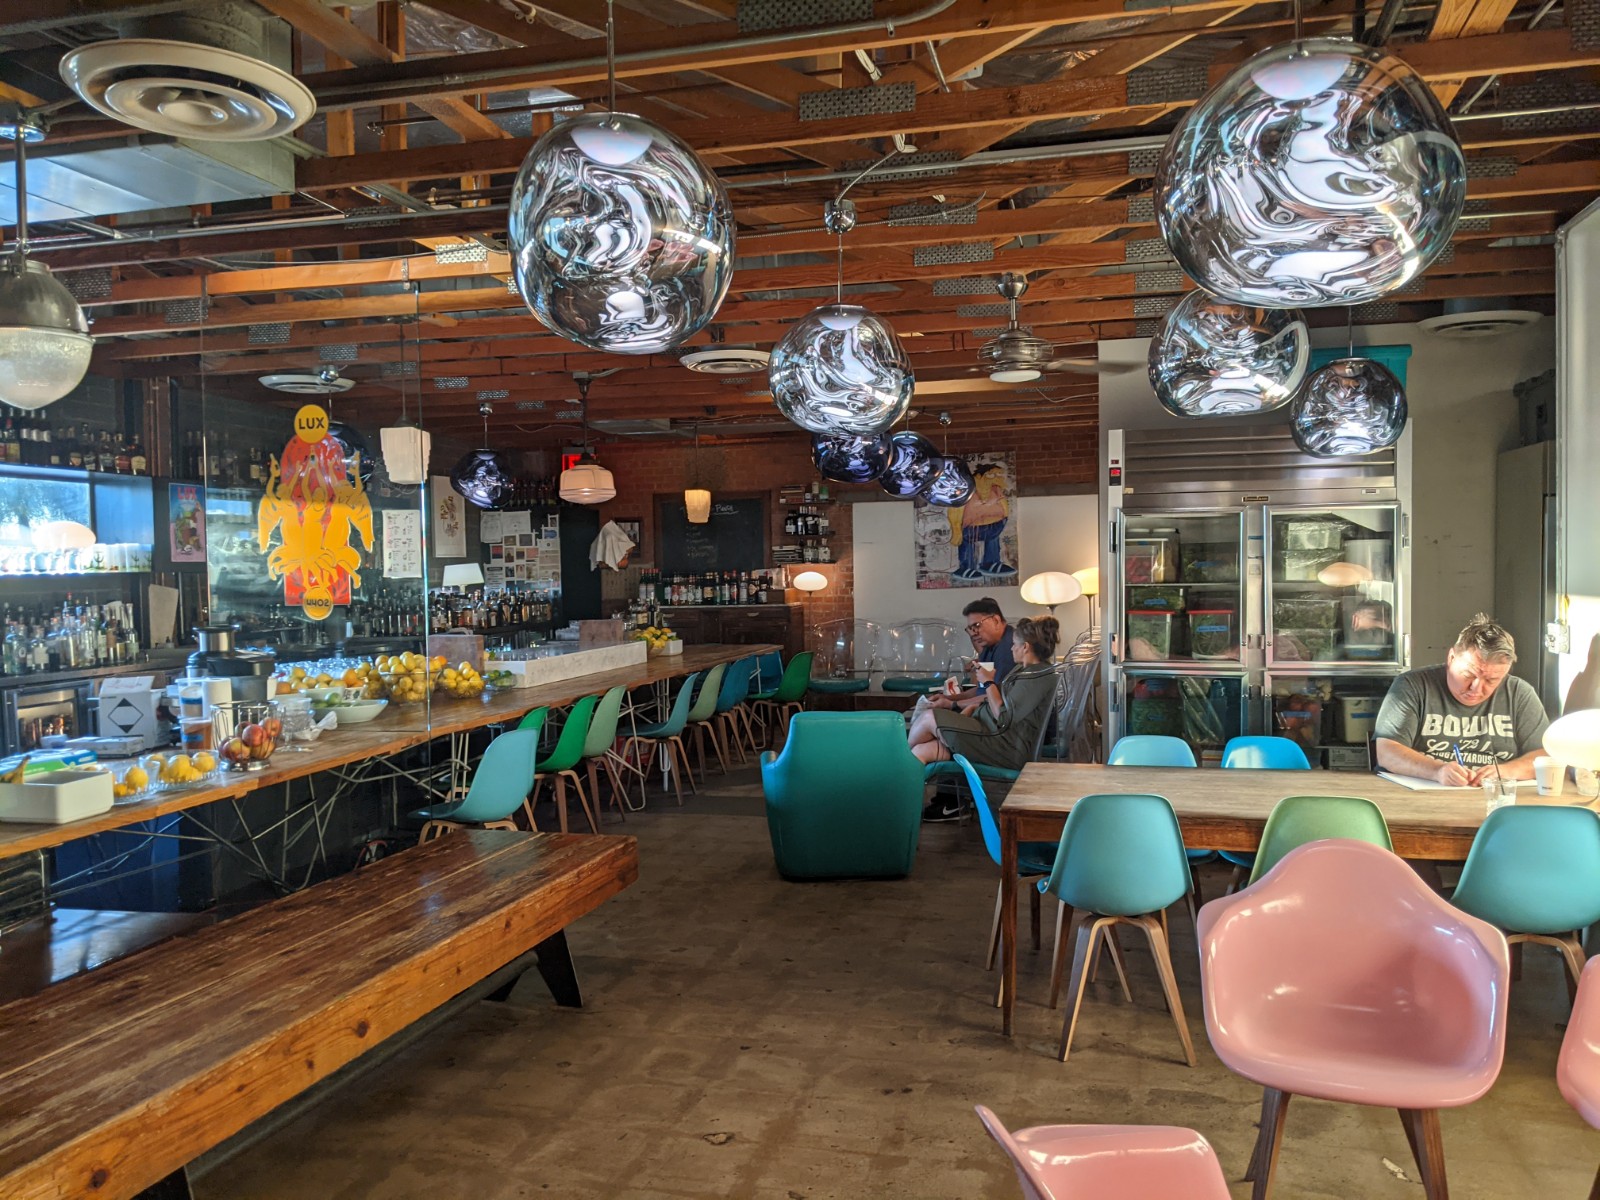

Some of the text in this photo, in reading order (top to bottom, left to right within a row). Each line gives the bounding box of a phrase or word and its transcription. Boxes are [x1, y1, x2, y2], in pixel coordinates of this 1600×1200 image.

[299, 417, 325, 430] LUX
[177, 487, 197, 500] LUX
[306, 599, 330, 607] 4402
[1421, 713, 1514, 737] BOWIE
